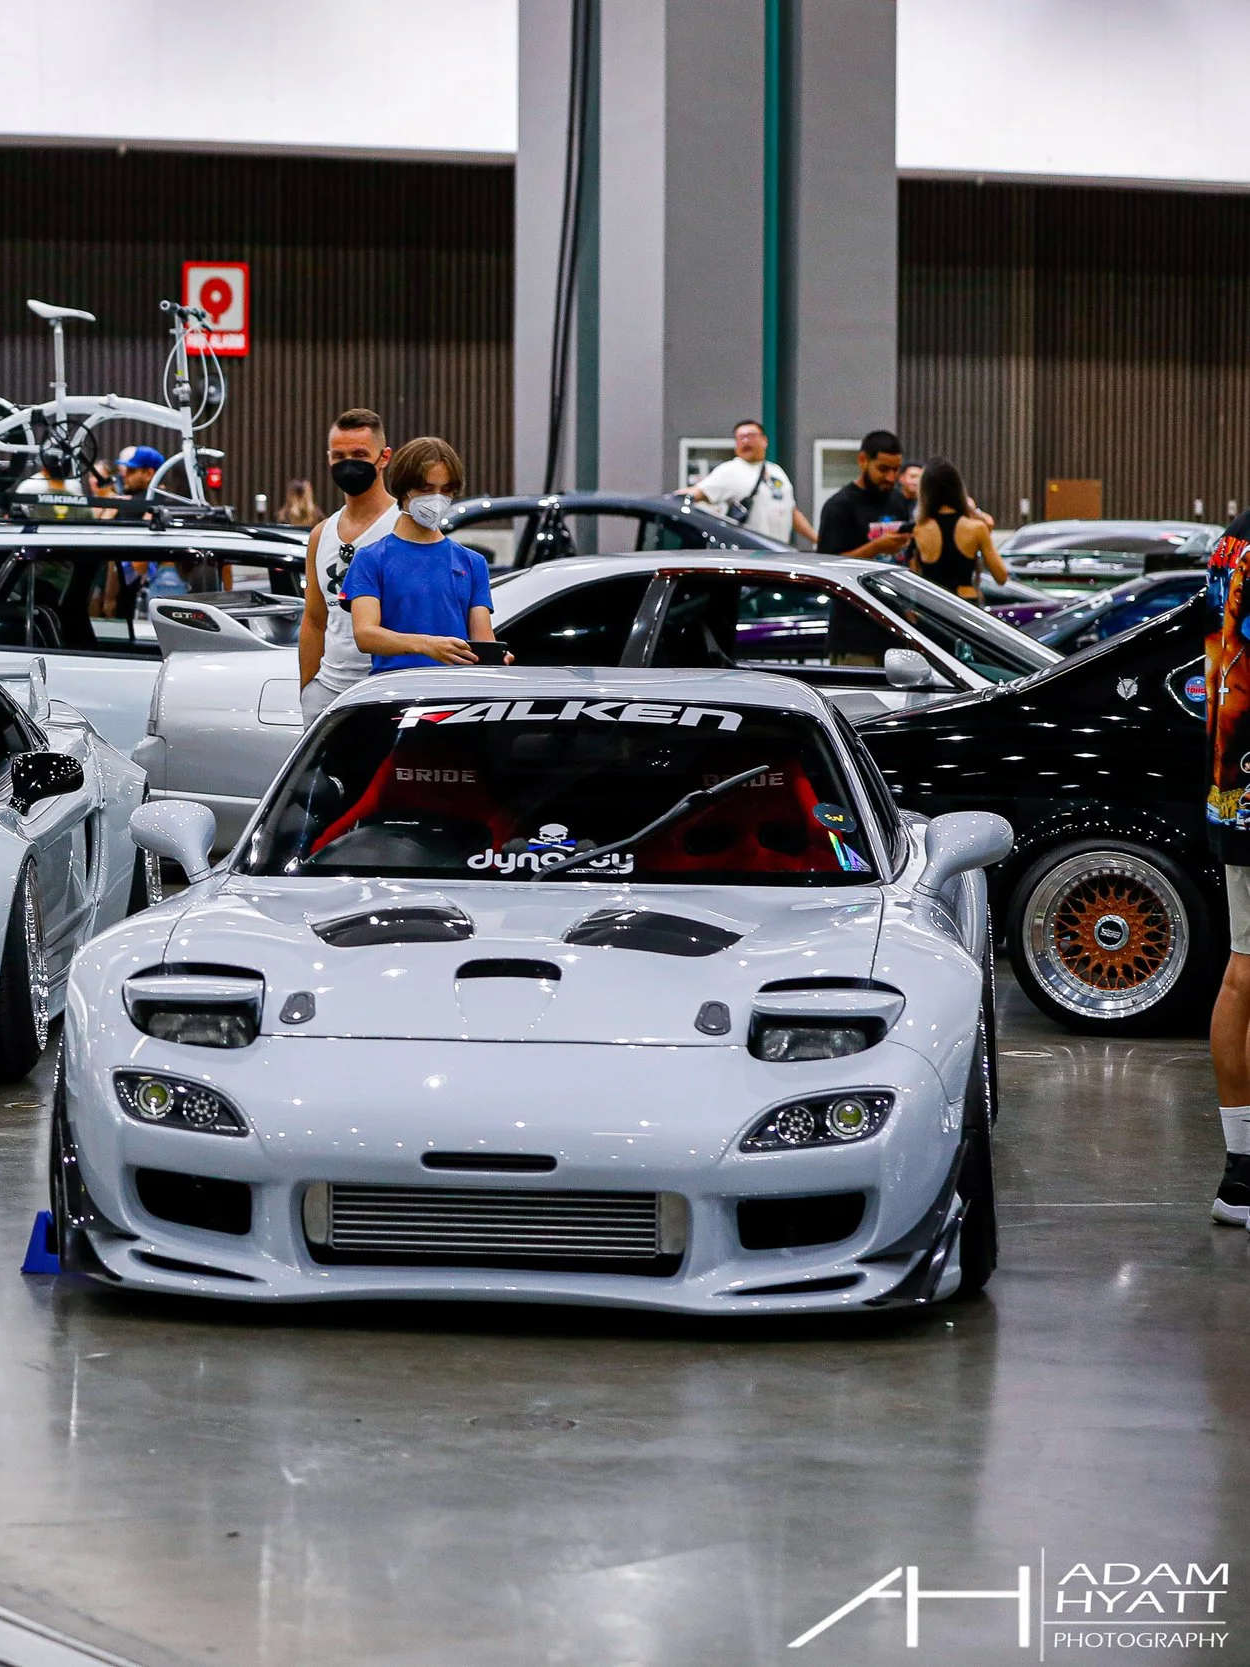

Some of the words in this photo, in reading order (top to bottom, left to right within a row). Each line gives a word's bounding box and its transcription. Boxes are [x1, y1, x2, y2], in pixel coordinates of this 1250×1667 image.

[393, 701, 743, 732] FALKEN
[396, 768, 476, 783] BRIDE
[703, 772, 785, 787] BDE
